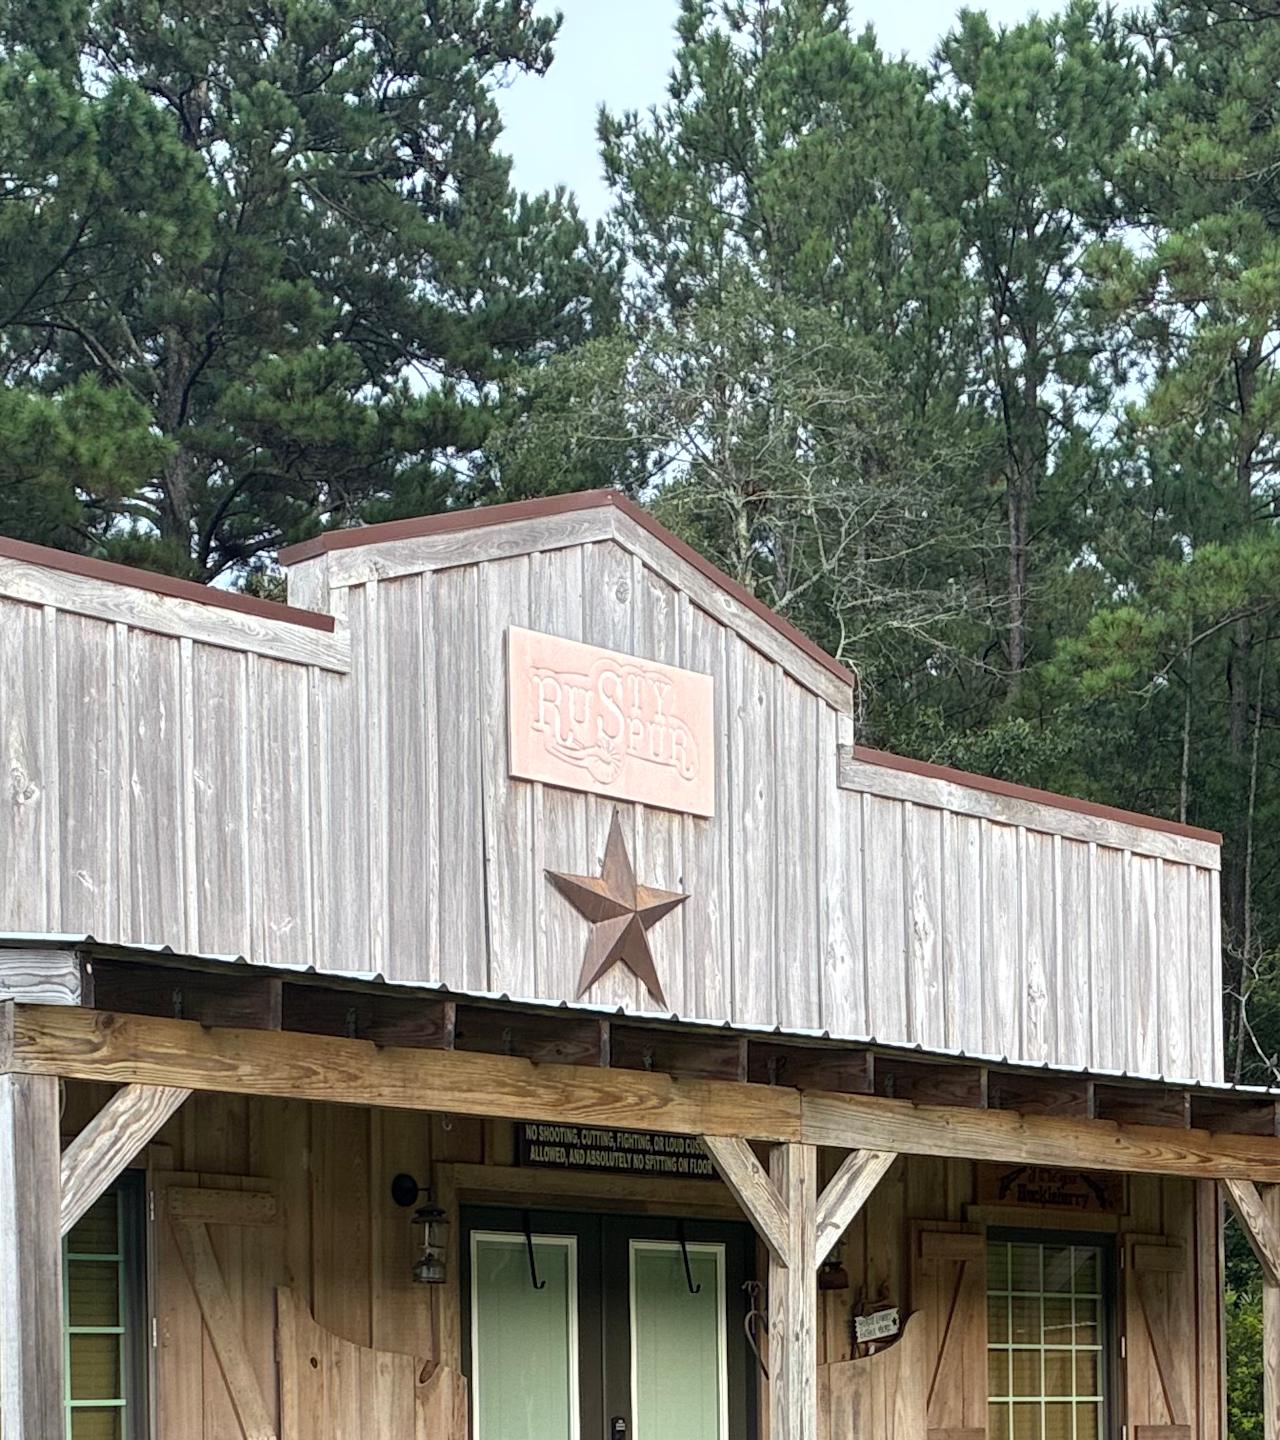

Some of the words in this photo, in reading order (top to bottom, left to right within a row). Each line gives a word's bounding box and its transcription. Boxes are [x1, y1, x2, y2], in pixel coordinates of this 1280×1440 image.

[525, 1124, 538, 1140] NO
[539, 1125, 580, 1147] SHOOTING,
[581, 1129, 616, 1150] CUTTING,
[617, 1132, 653, 1153] FIGHTING,
[654, 1136, 665, 1151] OR
[665, 1137, 685, 1153] LOUD
[530, 1144, 568, 1167] ALLOWED,
[569, 1148, 585, 1164] AND
[586, 1150, 632, 1168] ABSOLUTELY
[633, 1153, 644, 1169] NO
[645, 1154, 677, 1172] SPITTING
[678, 1157, 689, 1172] ON
[690, 1158, 713, 1174] FLOOR
